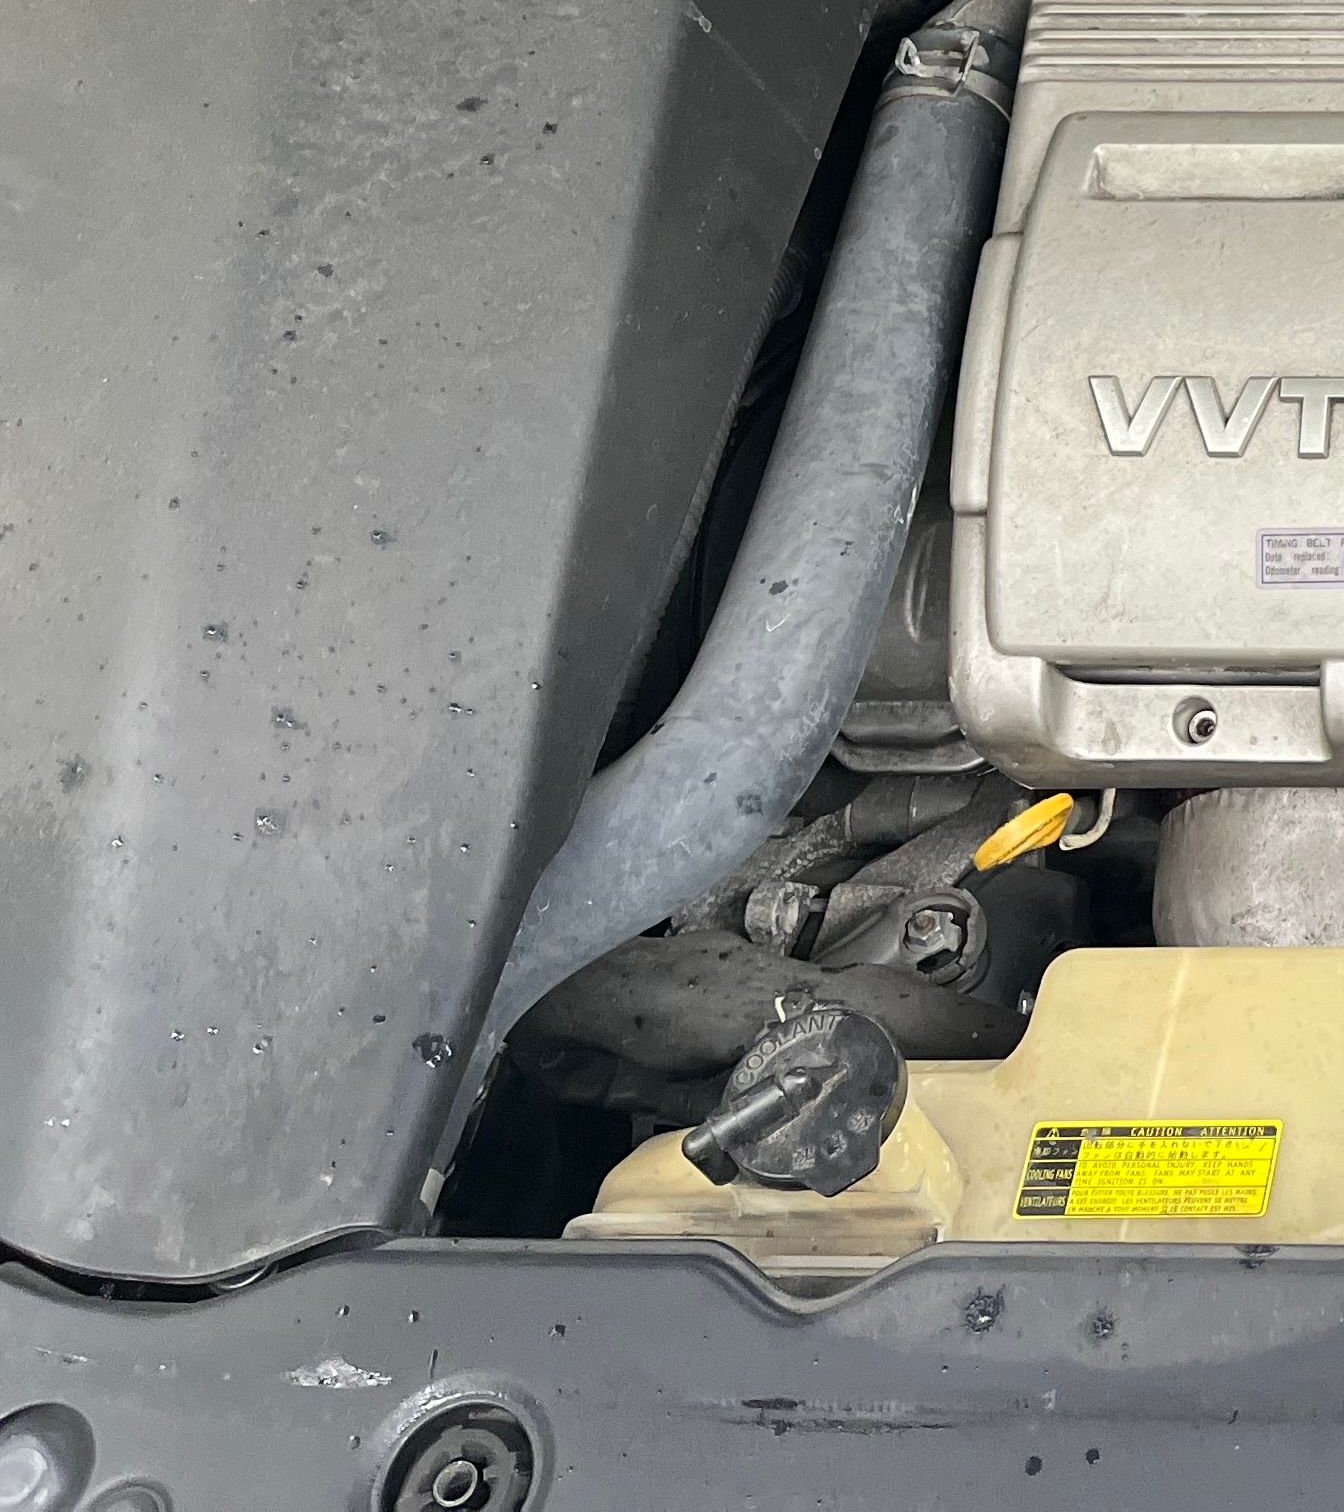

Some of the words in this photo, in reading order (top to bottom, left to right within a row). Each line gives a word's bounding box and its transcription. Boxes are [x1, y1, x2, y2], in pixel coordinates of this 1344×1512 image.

[1266, 538, 1298, 548] TIMING
[1306, 537, 1331, 548] BELT
[1265, 551, 1282, 563] Date
[736, 1014, 844, 1082] COOLANT
[1130, 1127, 1183, 1137] CAUTION
[1200, 1126, 1265, 1137] ATTENTION
[1122, 1161, 1160, 1169] PERSONAL
[1026, 1169, 1055, 1180] COOLING
[1055, 1168, 1074, 1180] FANS
[1097, 1178, 1134, 1186] IGNITION
[1020, 1195, 1066, 1208] VENTILATEURS
